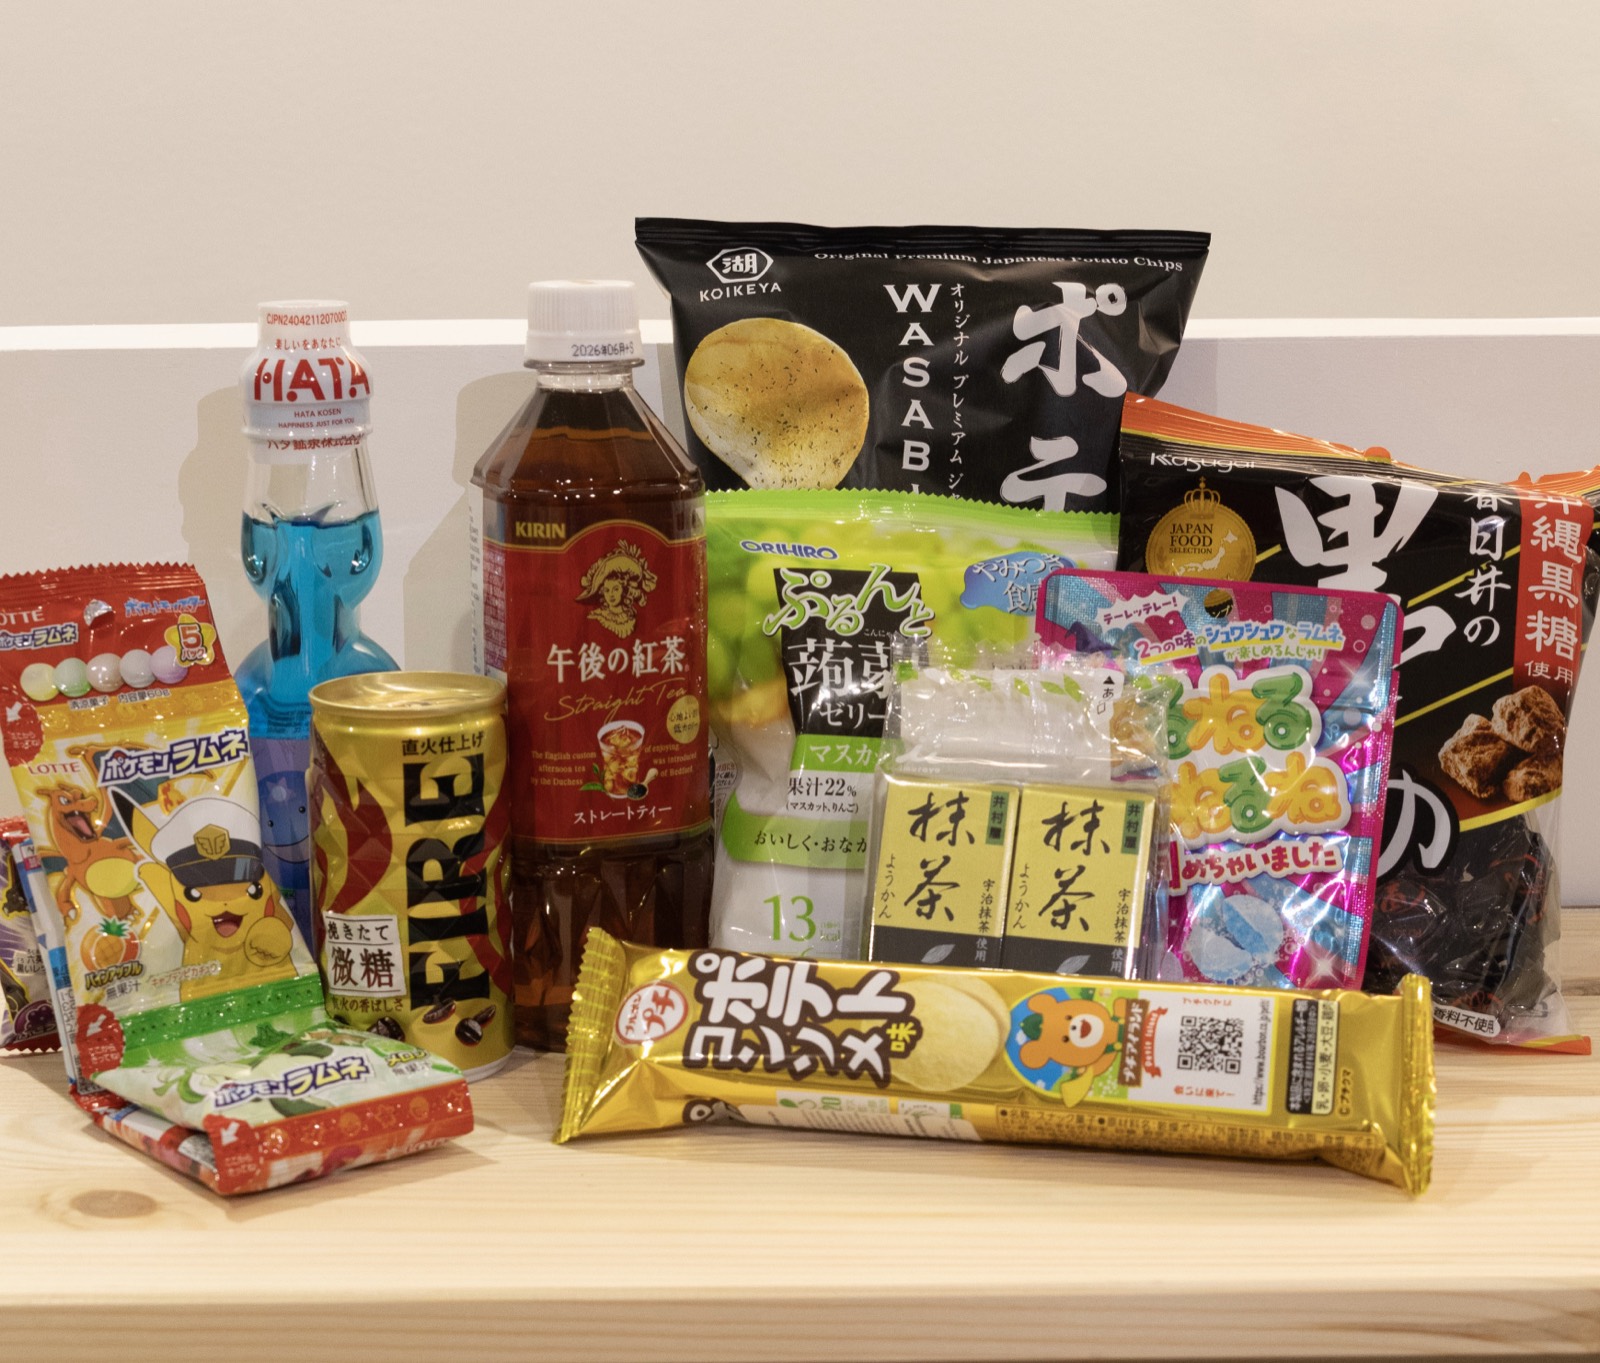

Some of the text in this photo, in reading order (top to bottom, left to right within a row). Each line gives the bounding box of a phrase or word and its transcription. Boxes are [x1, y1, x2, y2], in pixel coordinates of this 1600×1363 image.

[722, 253, 758, 274] 湖
[814, 252, 889, 261] Original
[895, 252, 978, 263] Premium
[981, 255, 1066, 265] Japanese
[1133, 256, 1183, 272] Chips
[700, 282, 782, 302] KOIKEYA
[253, 357, 371, 403] HATA
[278, 421, 314, 429] HAPPINESS
[331, 418, 344, 426] FOR
[344, 417, 355, 425] YOU
[294, 408, 342, 418] HATA KOSEN
[1150, 452, 1256, 473] Kasugai
[515, 521, 567, 539] KIRIN
[1169, 523, 1214, 535] JAPAN
[1169, 535, 1213, 547] FOOD
[740, 540, 840, 561] ORIHIRO
[762, 563, 936, 637] ぷるんと
[0, 608, 45, 624] OTTE
[179, 623, 202, 648] 5
[546, 635, 686, 684] 午後の紅茶
[544, 677, 687, 724] Straight Tea
[819, 702, 887, 730] ゼリー
[100, 727, 250, 783] ポケモンラムネ
[401, 731, 485, 757] 直火仕上げ
[544, 750, 571, 761] English
[572, 751, 597, 759] custom
[809, 743, 880, 766] マスカ
[28, 761, 81, 776] LOTTE
[553, 777, 584, 786] Duchess
[573, 804, 673, 825] ストレートティー
[903, 790, 976, 922] 抹茶
[1038, 799, 1111, 932] 抹茶
[1159, 839, 1338, 889] めちゃいました
[402, 752, 491, 1012] FIRE
[878, 852, 896, 920] ようかん
[1012, 862, 1031, 930] ようかん
[327, 920, 389, 941] 挽きたて
[762, 894, 817, 942] 13
[331, 946, 396, 988] 微糖
[106, 982, 142, 1000] 無果汁
[692, 951, 909, 1028] ポテト
[687, 1019, 918, 1082] コンソメ味
[1124, 1001, 1144, 1083] プチアイランド
